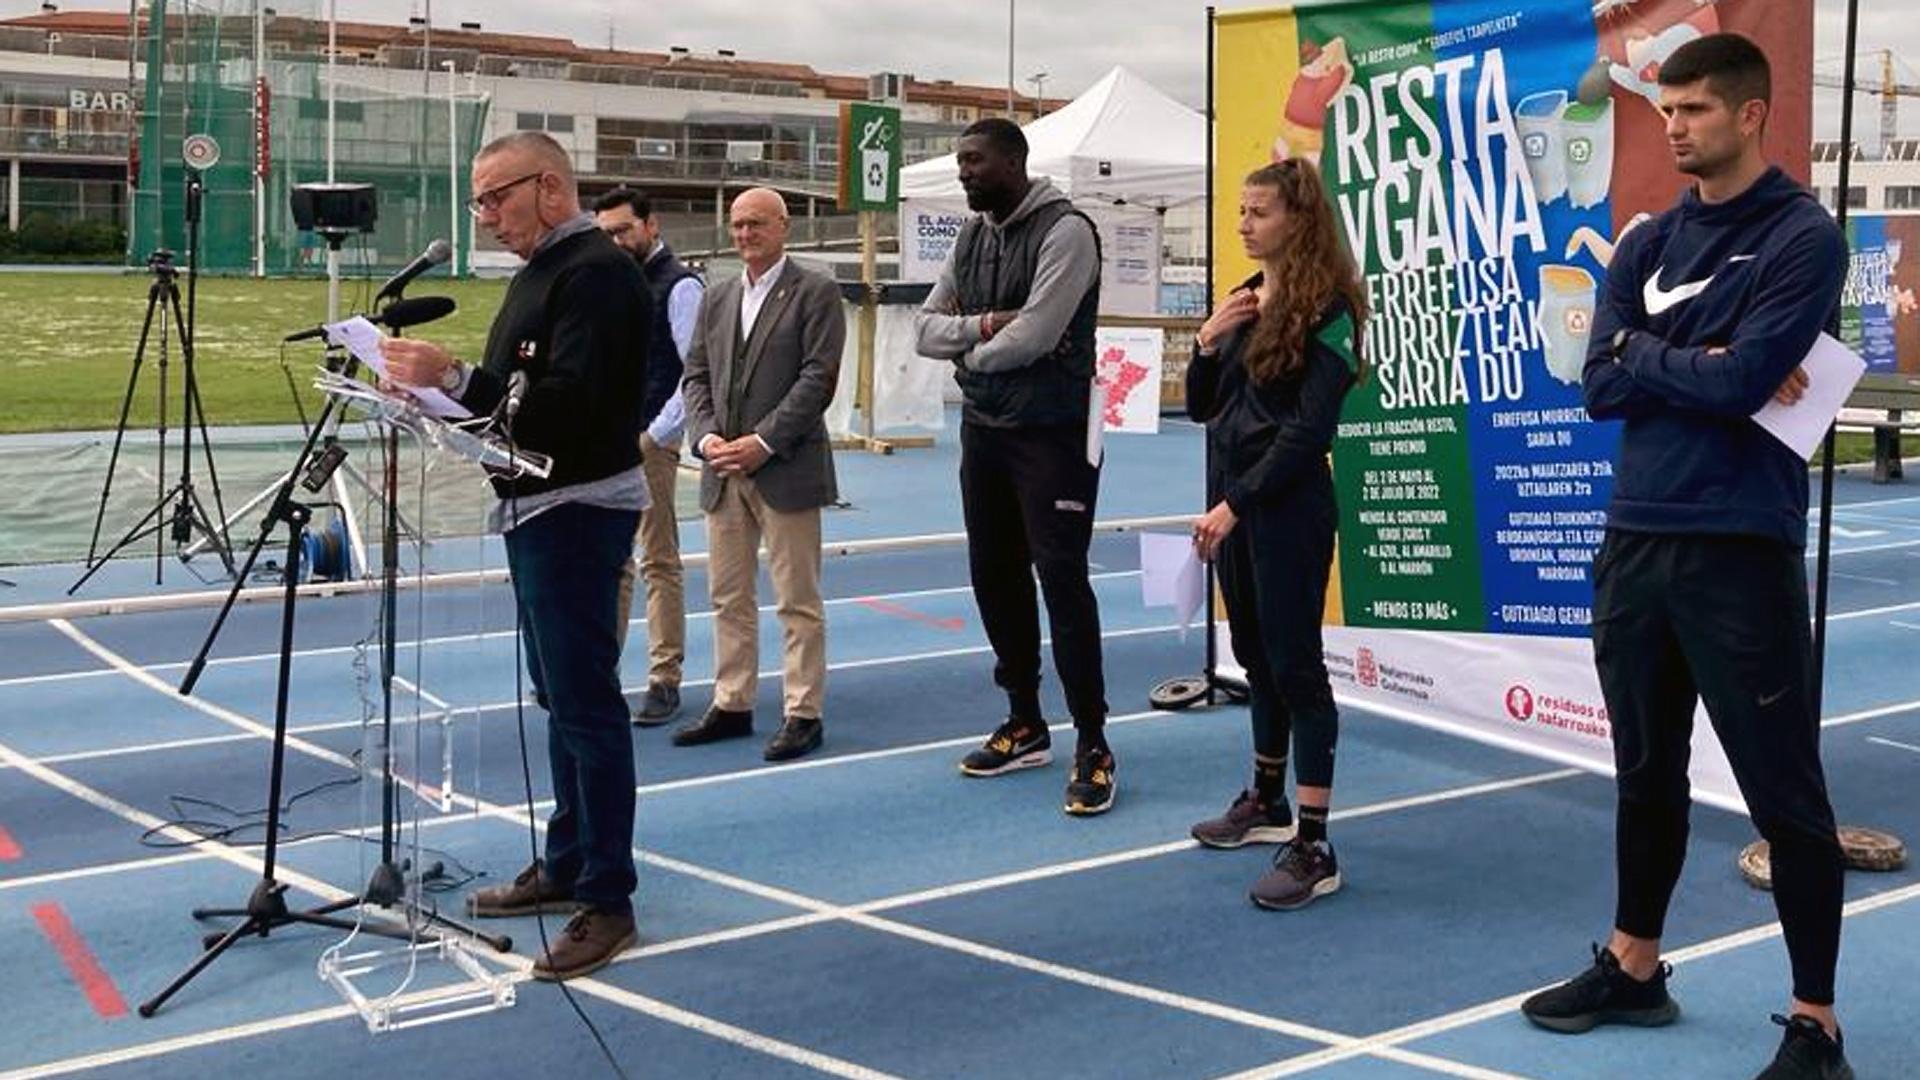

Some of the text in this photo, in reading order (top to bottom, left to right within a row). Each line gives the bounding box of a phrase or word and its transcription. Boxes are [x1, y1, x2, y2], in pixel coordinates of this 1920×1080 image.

[70, 89, 129, 110] BAR
[1334, 49, 1526, 185] RESTA
[918, 226, 957, 238] COMO
[1366, 257, 1523, 320] ERREFUSA
[1377, 350, 1523, 409] SARIA DU
[1374, 601, 1409, 619] MENOS
[1411, 601, 1424, 619] ES
[1425, 600, 1450, 620] MÁS
[1502, 605, 1557, 624] GUTXIAGO
[1558, 607, 1593, 625] GEHIA
[1538, 695, 1594, 718] residuos
[1537, 711, 1607, 738] nafarroako
